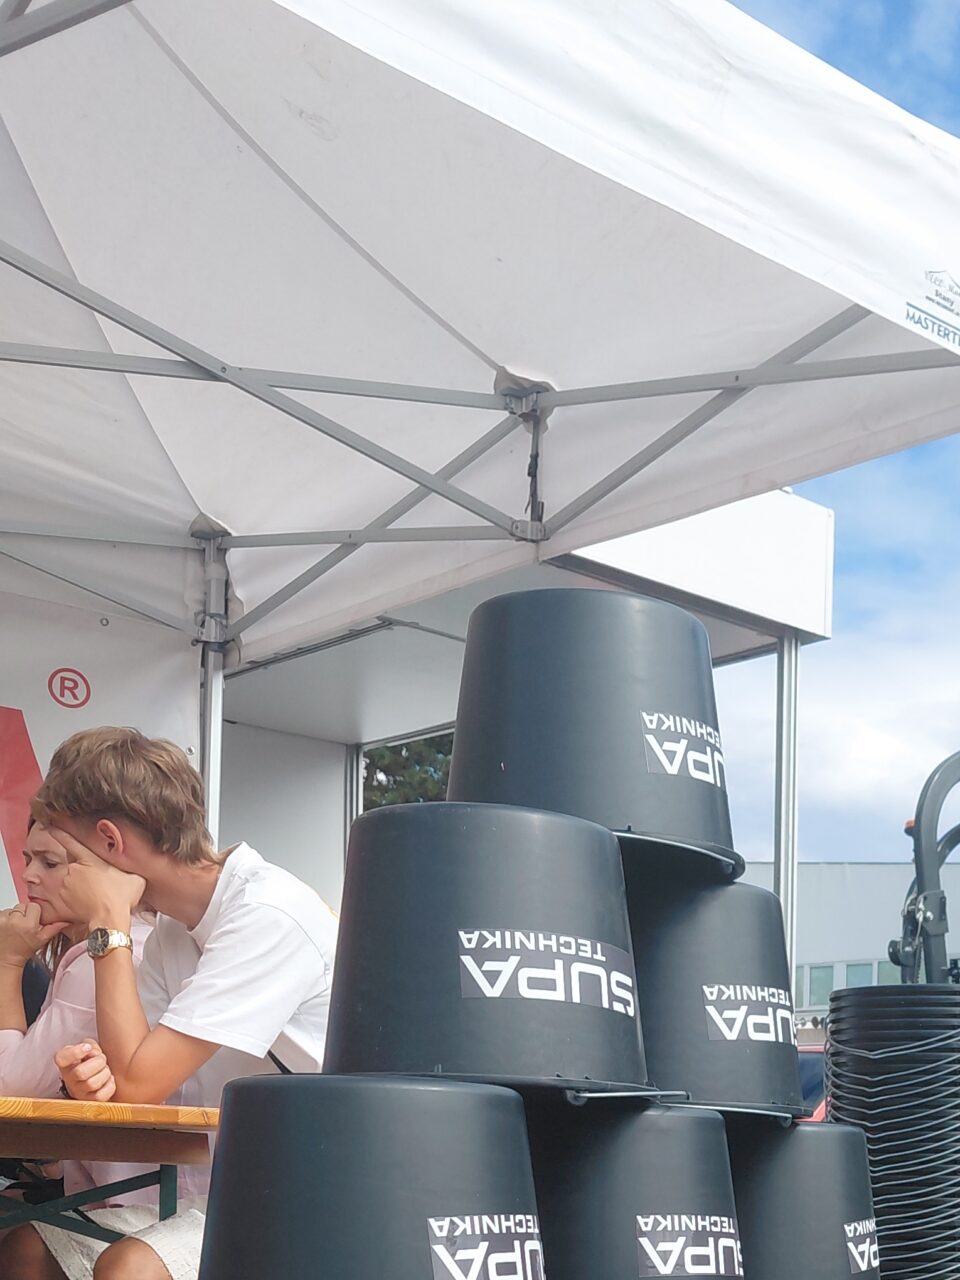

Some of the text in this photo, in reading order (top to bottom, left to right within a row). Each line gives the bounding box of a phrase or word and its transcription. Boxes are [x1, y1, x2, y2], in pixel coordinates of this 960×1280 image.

[641, 711, 722, 749] ECHNIKA
[645, 734, 725, 788] UPA
[458, 930, 607, 962] TECHNIKA
[459, 954, 636, 1018] SUPA
[702, 985, 791, 1006] TECHNIKA
[705, 1005, 797, 1047] UPA
[636, 1215, 736, 1233] TECHNIKA
